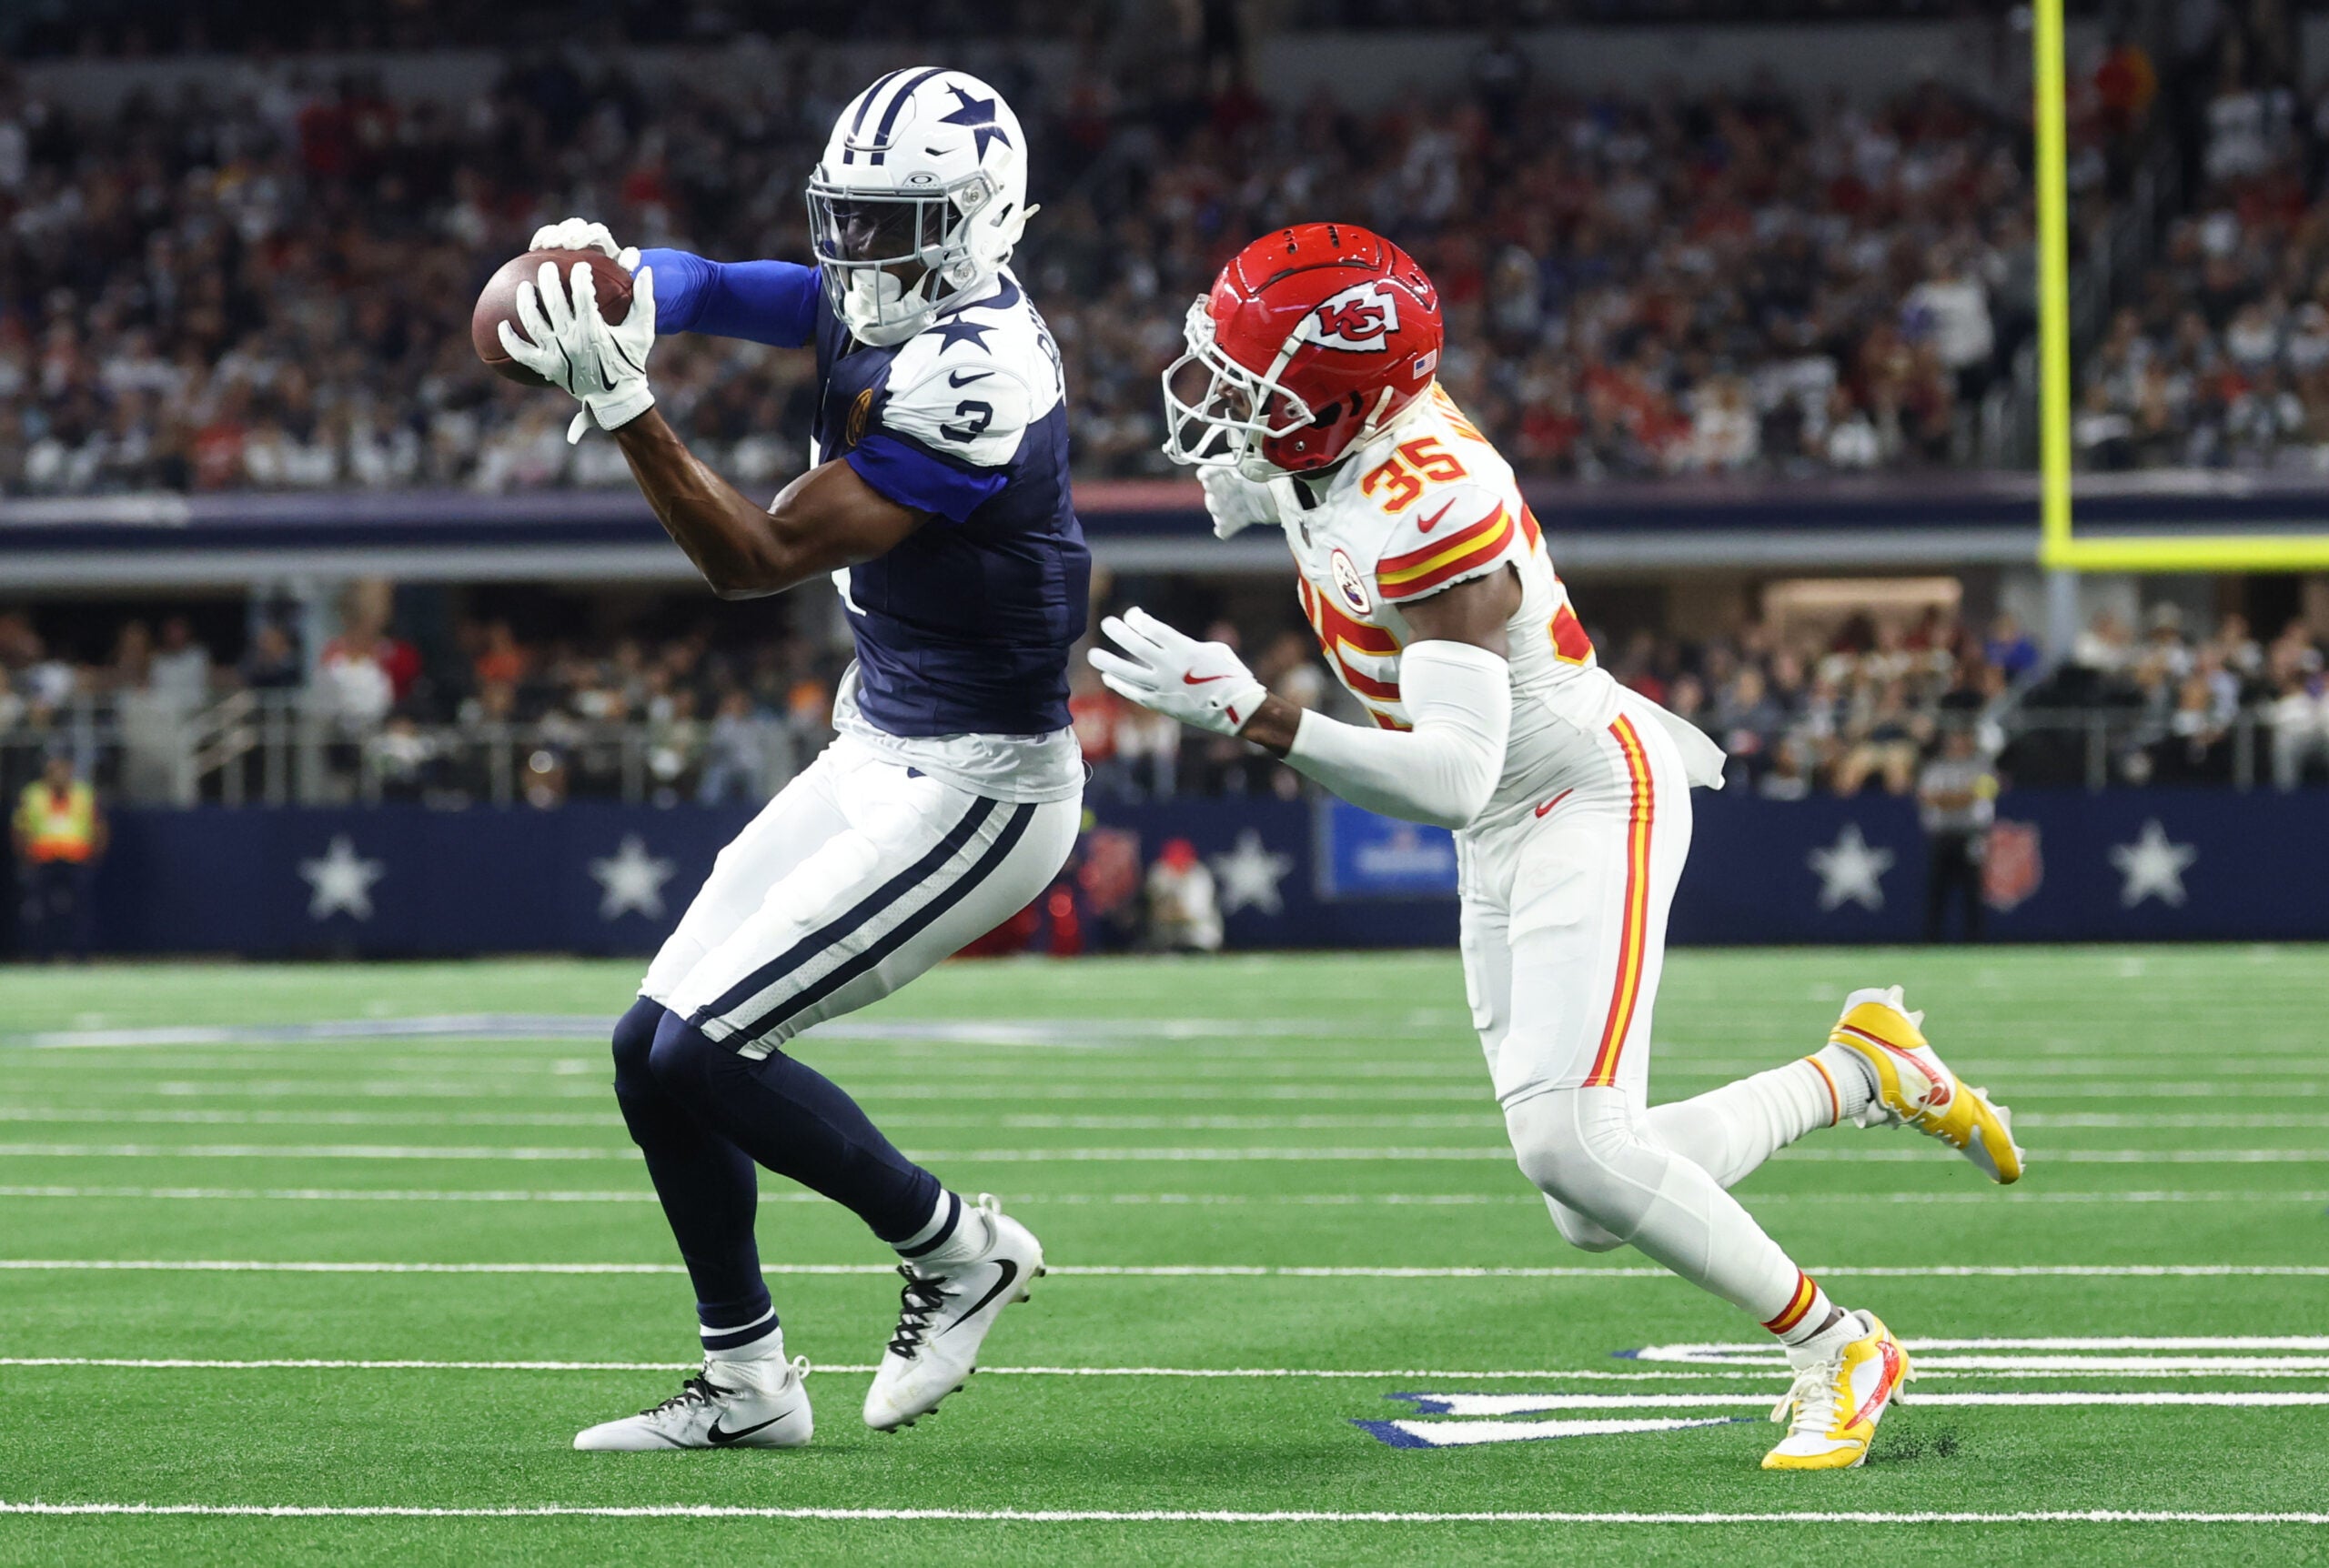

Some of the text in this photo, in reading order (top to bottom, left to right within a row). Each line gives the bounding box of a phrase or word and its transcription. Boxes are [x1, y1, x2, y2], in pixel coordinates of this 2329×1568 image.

[1316, 298, 1386, 342] KC
[940, 399, 993, 444] 3
[1360, 436, 1469, 516] 35
